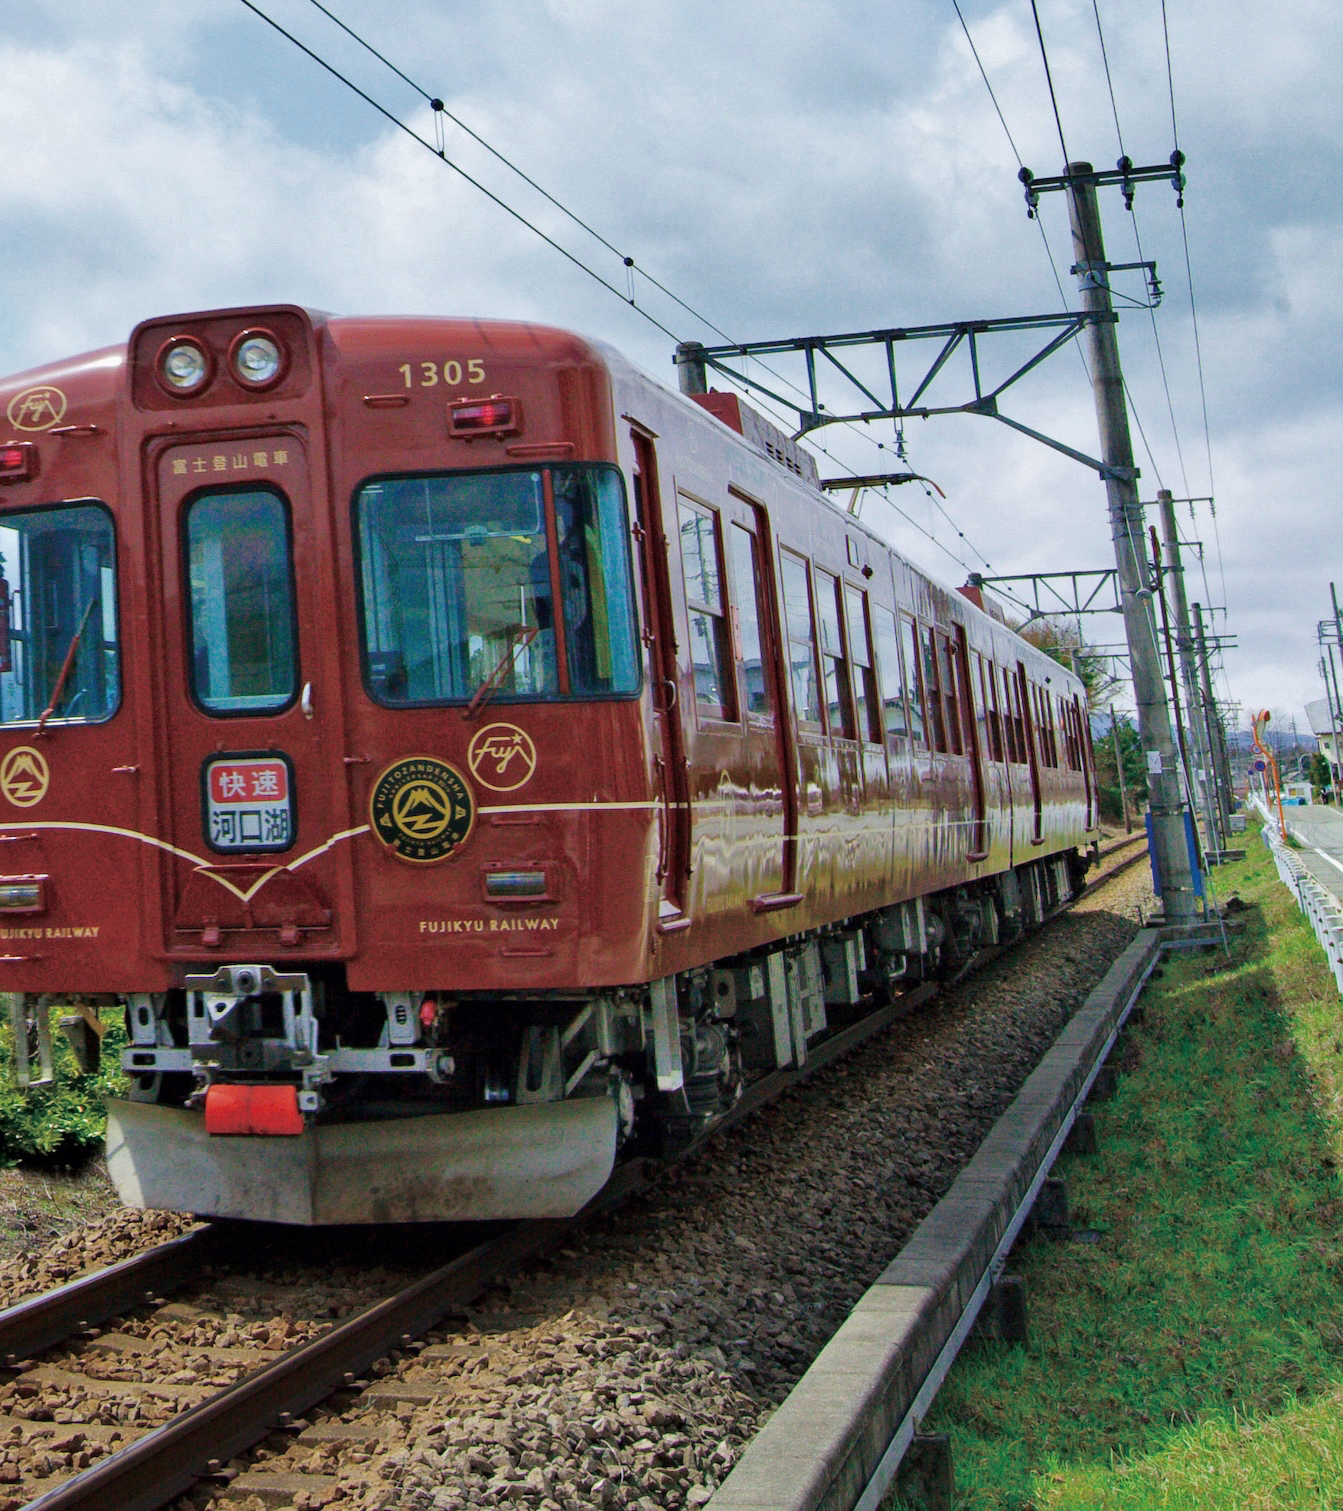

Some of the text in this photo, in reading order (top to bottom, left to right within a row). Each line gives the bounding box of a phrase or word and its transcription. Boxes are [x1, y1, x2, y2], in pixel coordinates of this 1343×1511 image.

[398, 359, 486, 388] 1305
[172, 450, 289, 474] 富士登山電車
[218, 769, 280, 798] 快速
[377, 764, 464, 808] FUJITOZANDENSHA
[212, 808, 288, 843] 河口湖
[45, 926, 100, 938] RAILWAY
[419, 918, 559, 933] FUJIKYU RAILWAY
